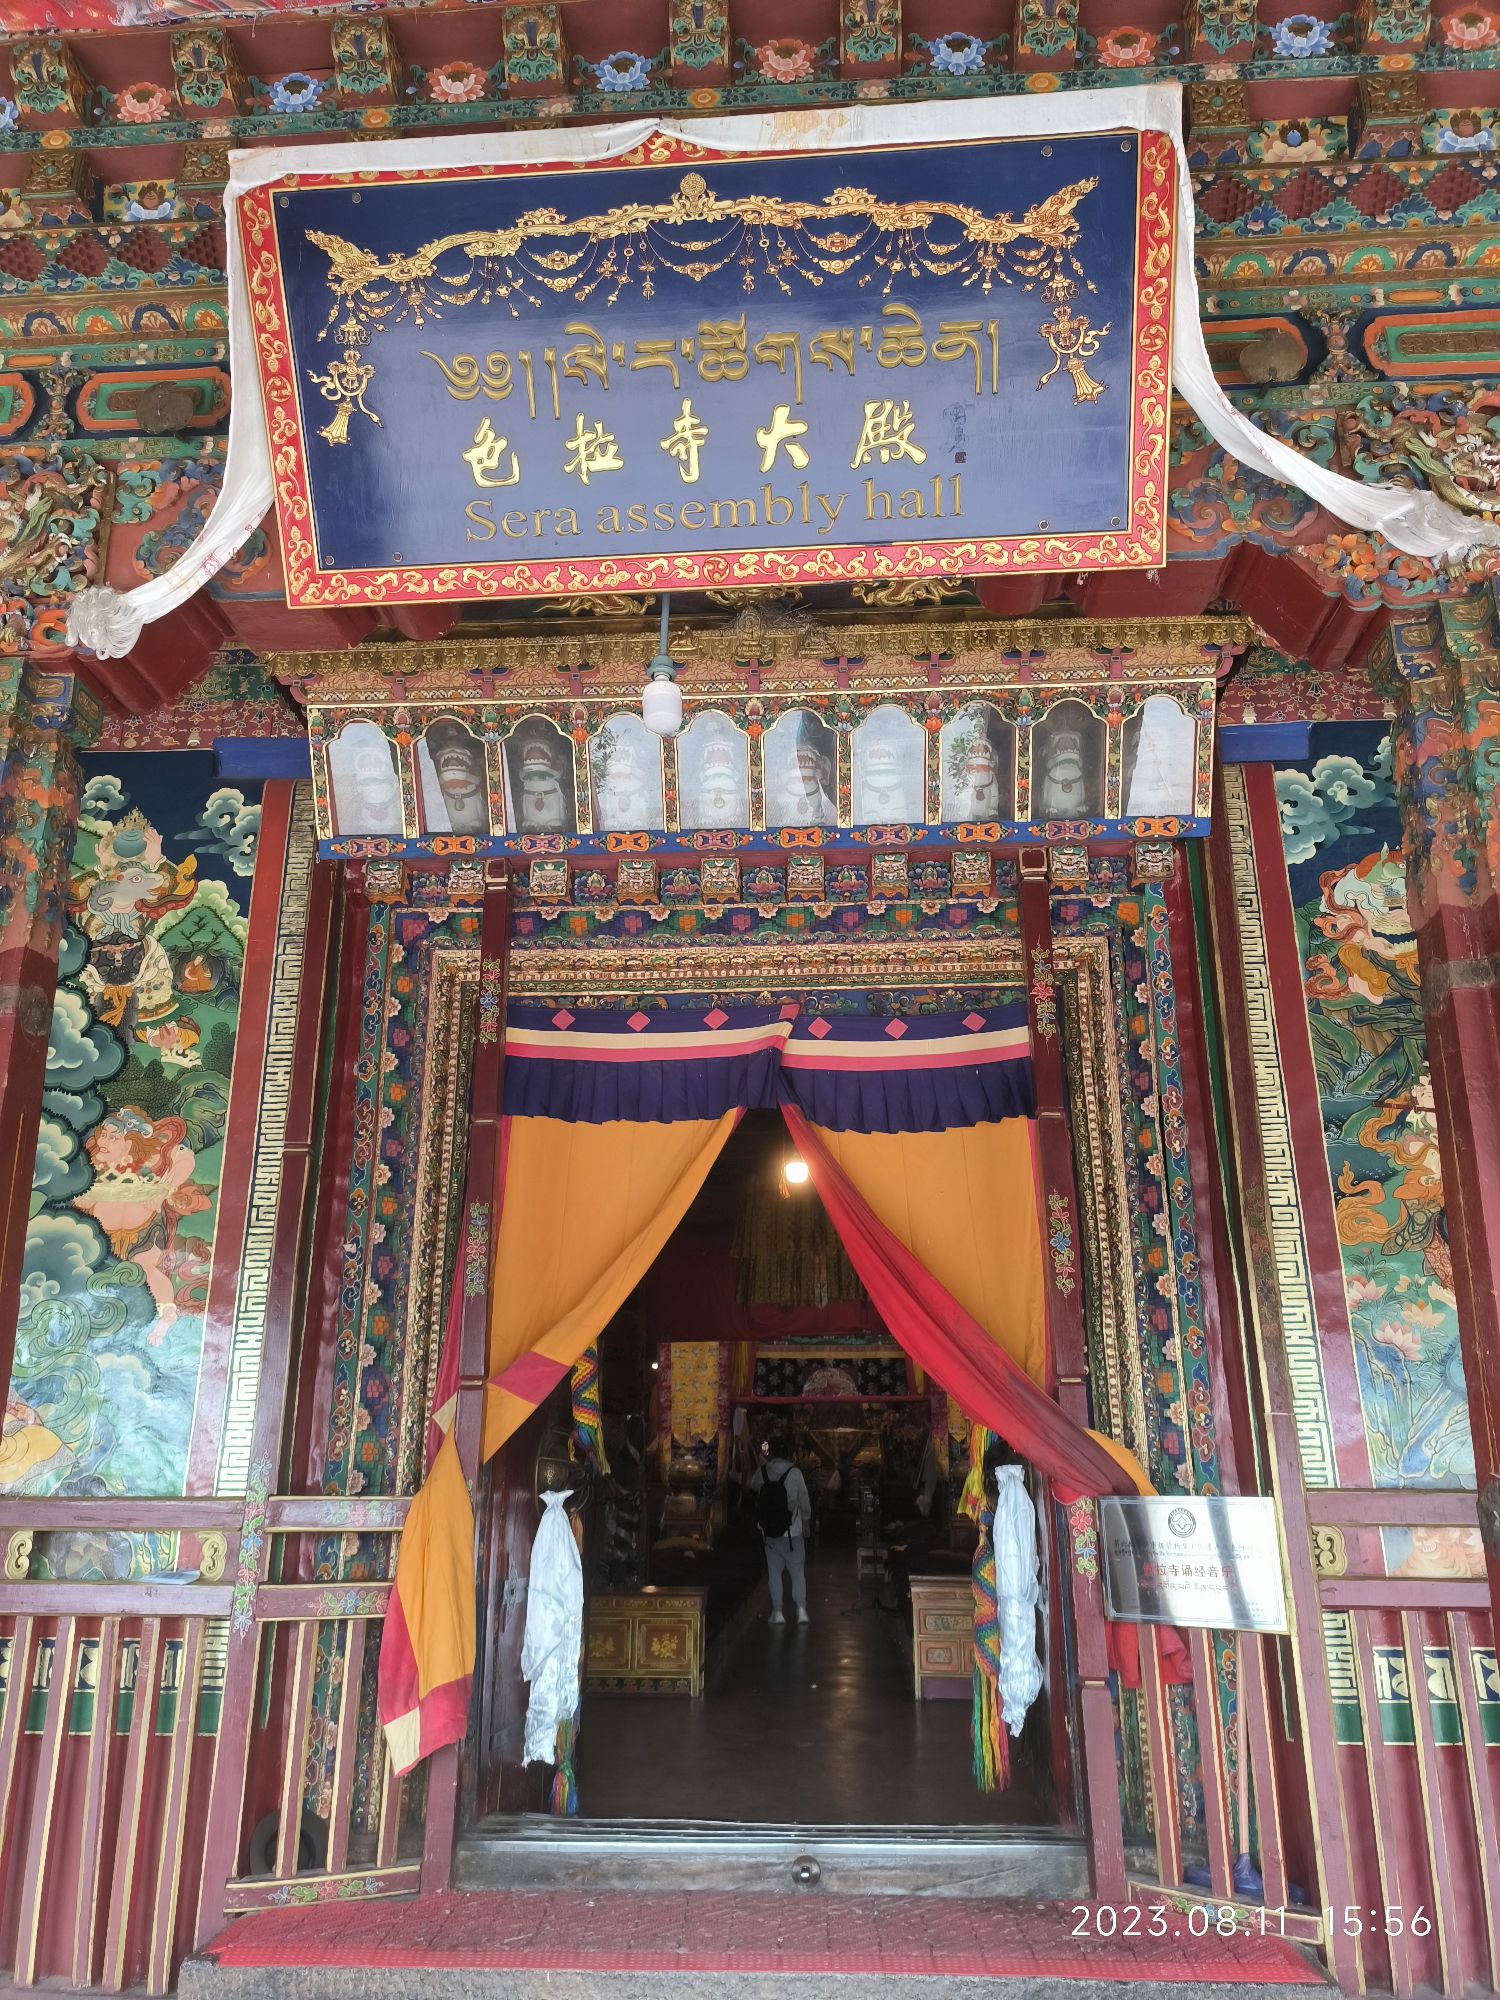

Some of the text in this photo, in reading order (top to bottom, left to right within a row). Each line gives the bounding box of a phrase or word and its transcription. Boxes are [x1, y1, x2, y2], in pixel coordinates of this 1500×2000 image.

[462, 398, 927, 488] 色拉寺大殿
[464, 472, 967, 542] Sera assembly hall
